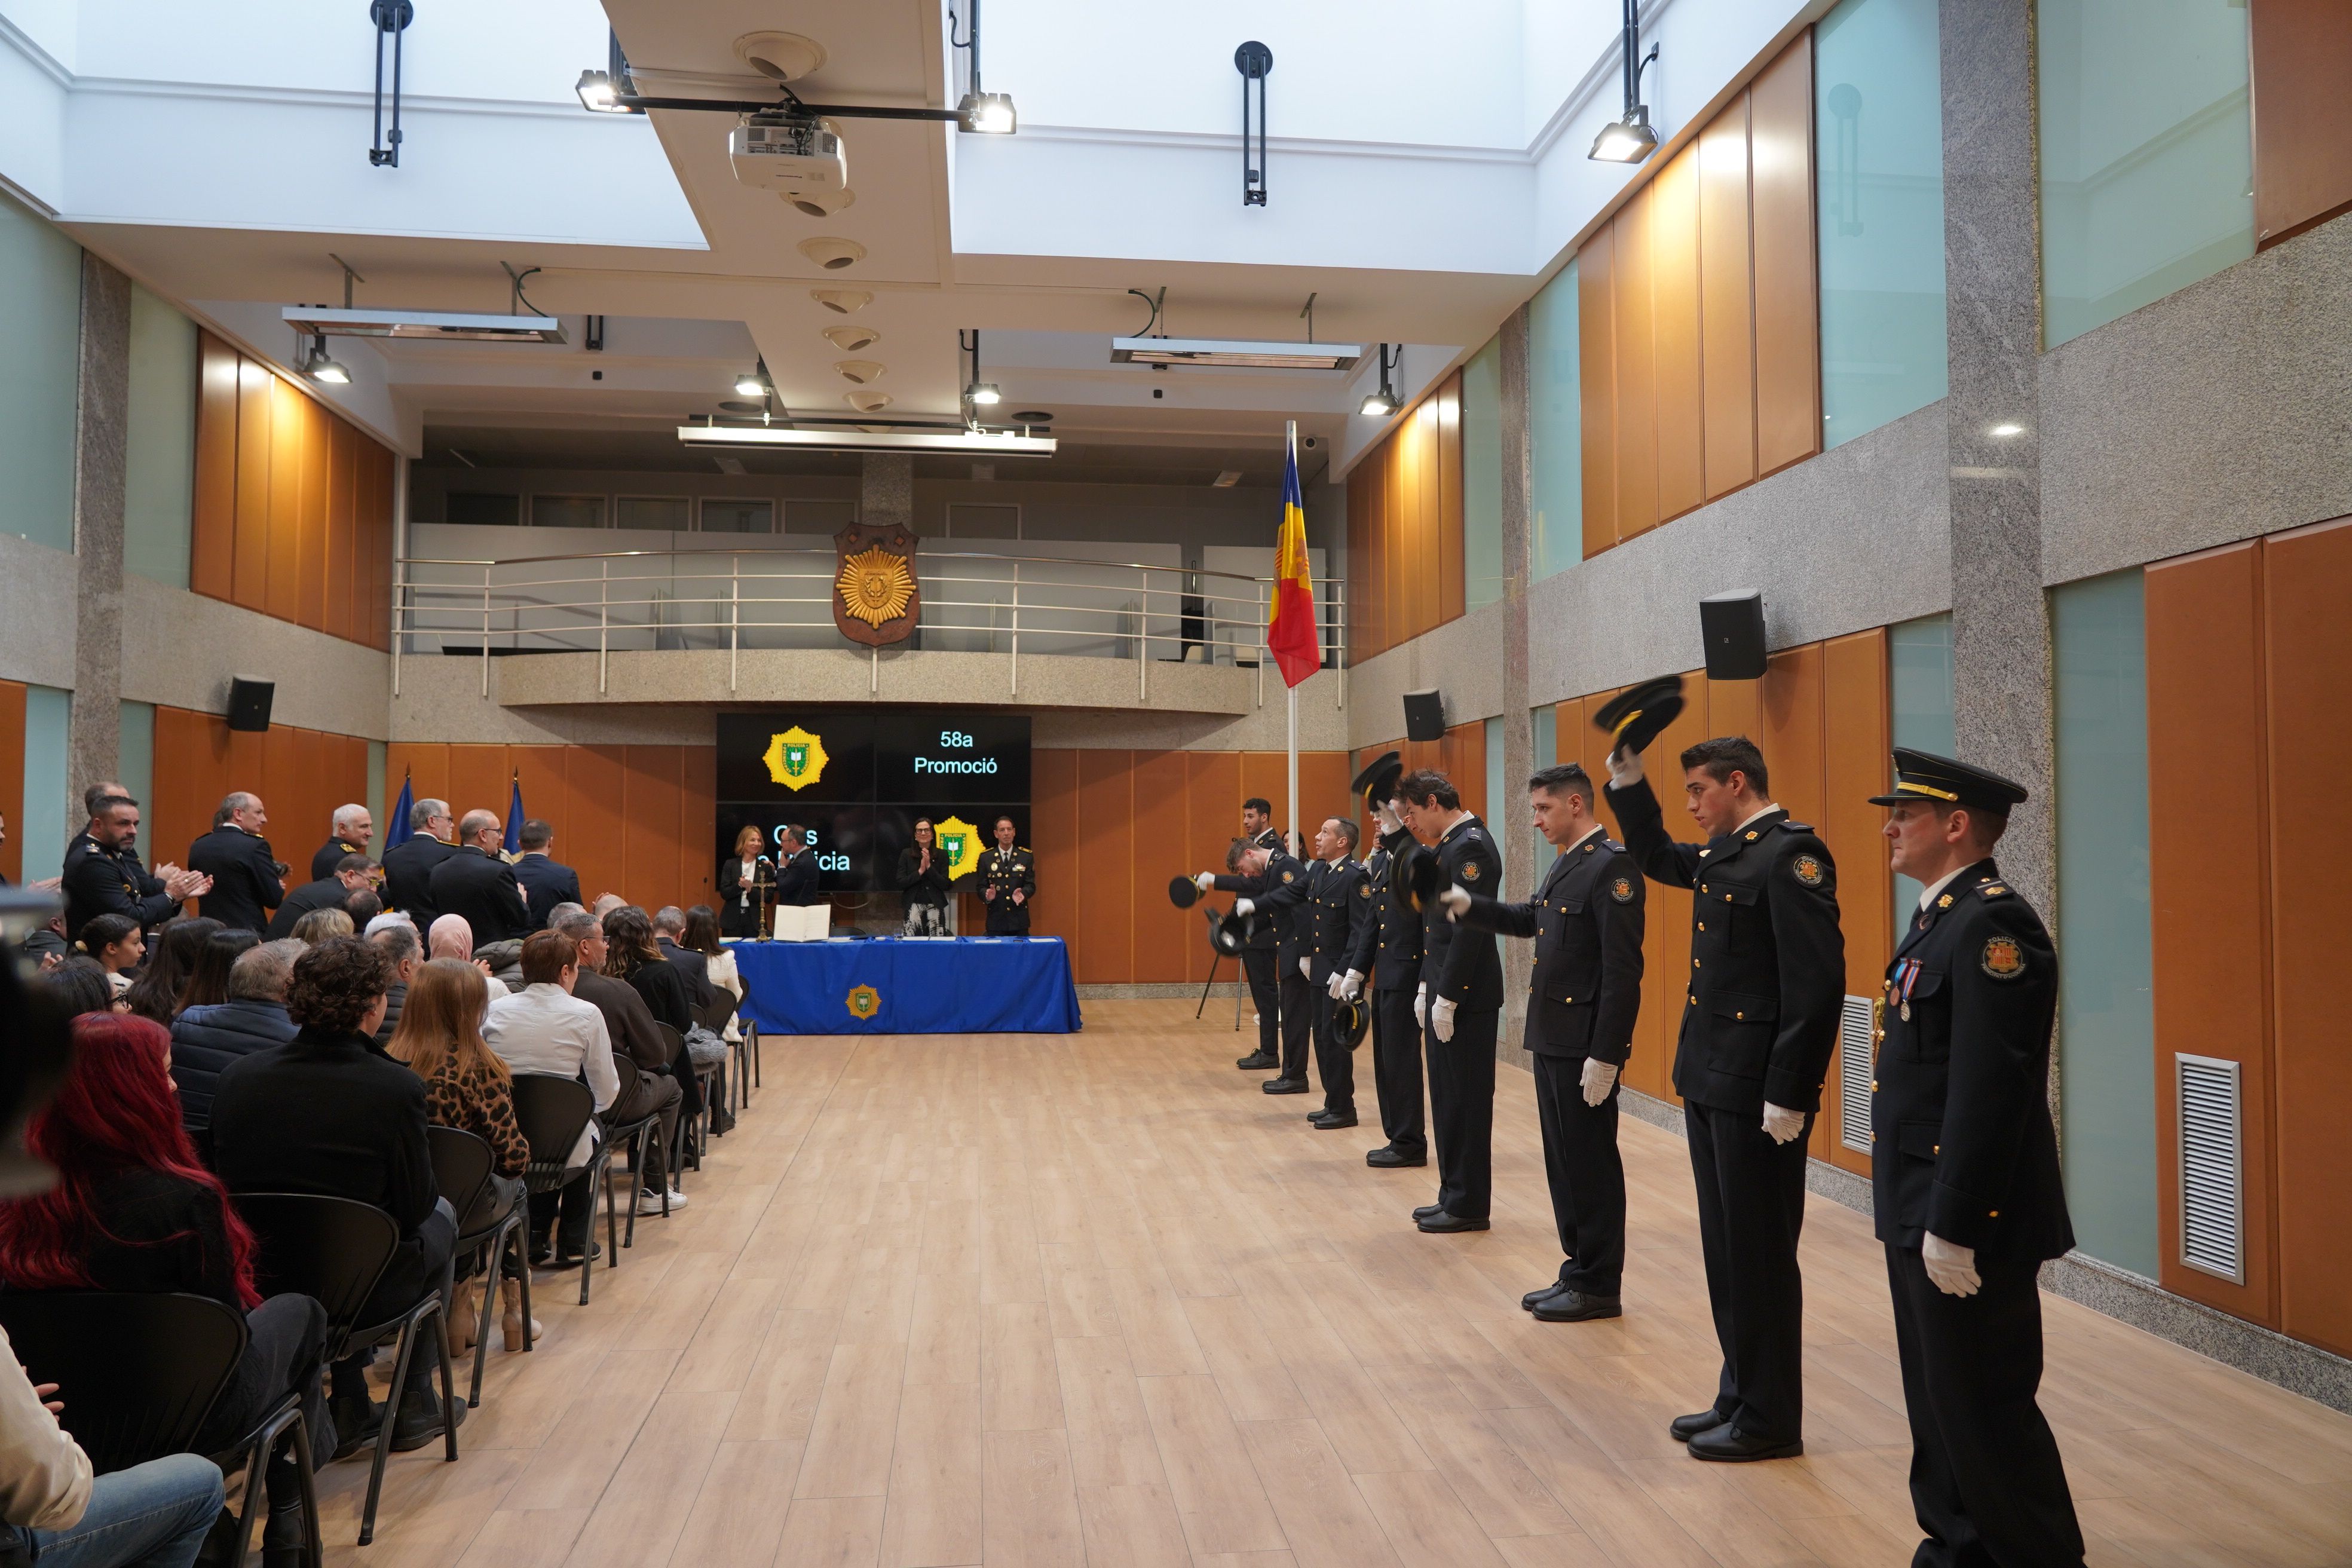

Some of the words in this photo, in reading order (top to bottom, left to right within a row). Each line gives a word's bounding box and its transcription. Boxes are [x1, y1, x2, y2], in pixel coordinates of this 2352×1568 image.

[941, 731, 973, 747] 58a
[915, 757, 997, 773] Promoció
[774, 825, 818, 845] Cs
